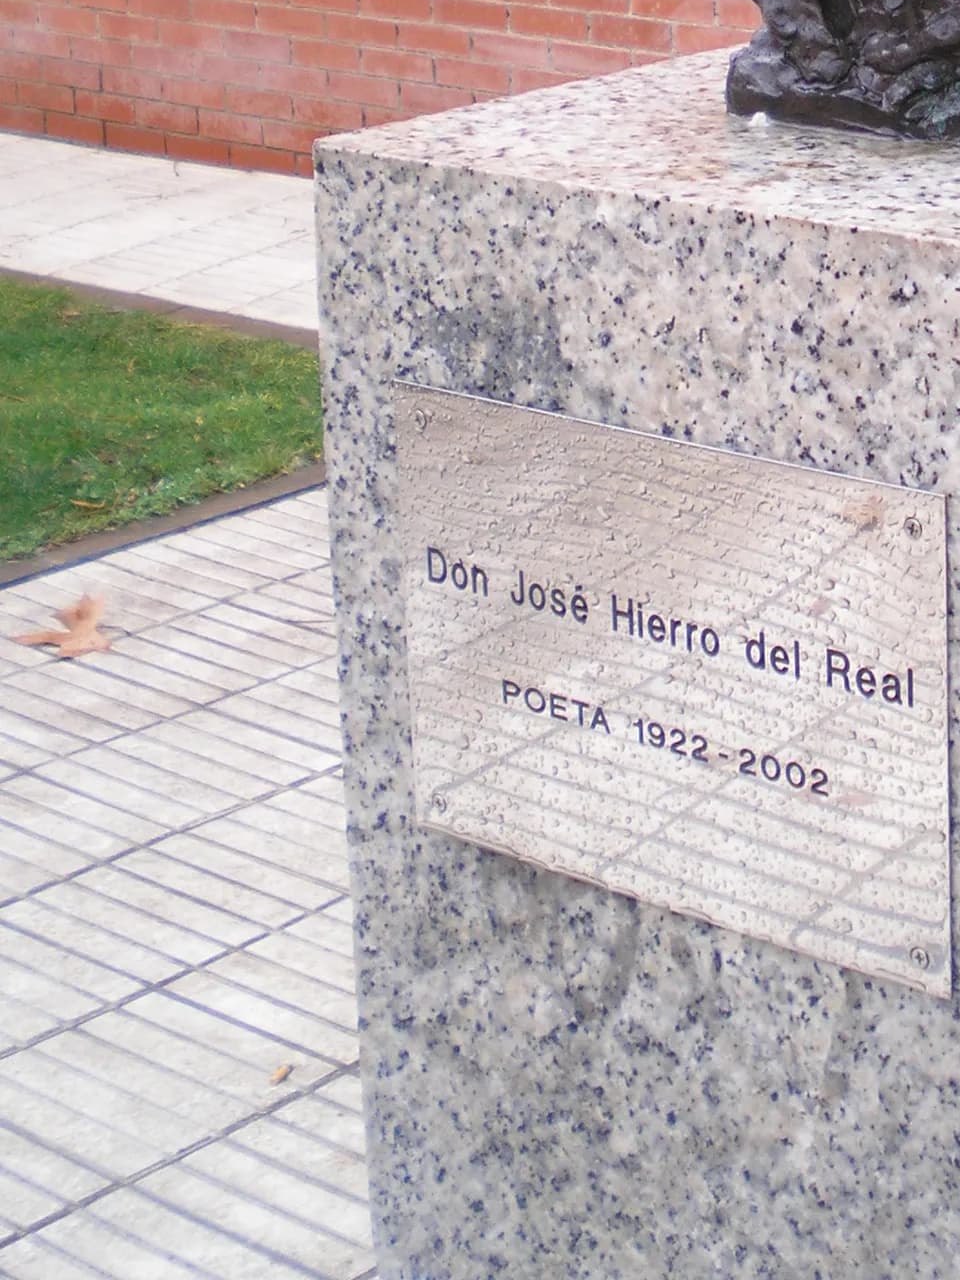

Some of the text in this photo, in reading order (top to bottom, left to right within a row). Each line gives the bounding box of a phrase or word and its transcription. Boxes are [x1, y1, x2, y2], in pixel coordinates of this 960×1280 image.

[426, 545, 915, 709] Don José Hierro del Real
[501, 678, 611, 735] POETA
